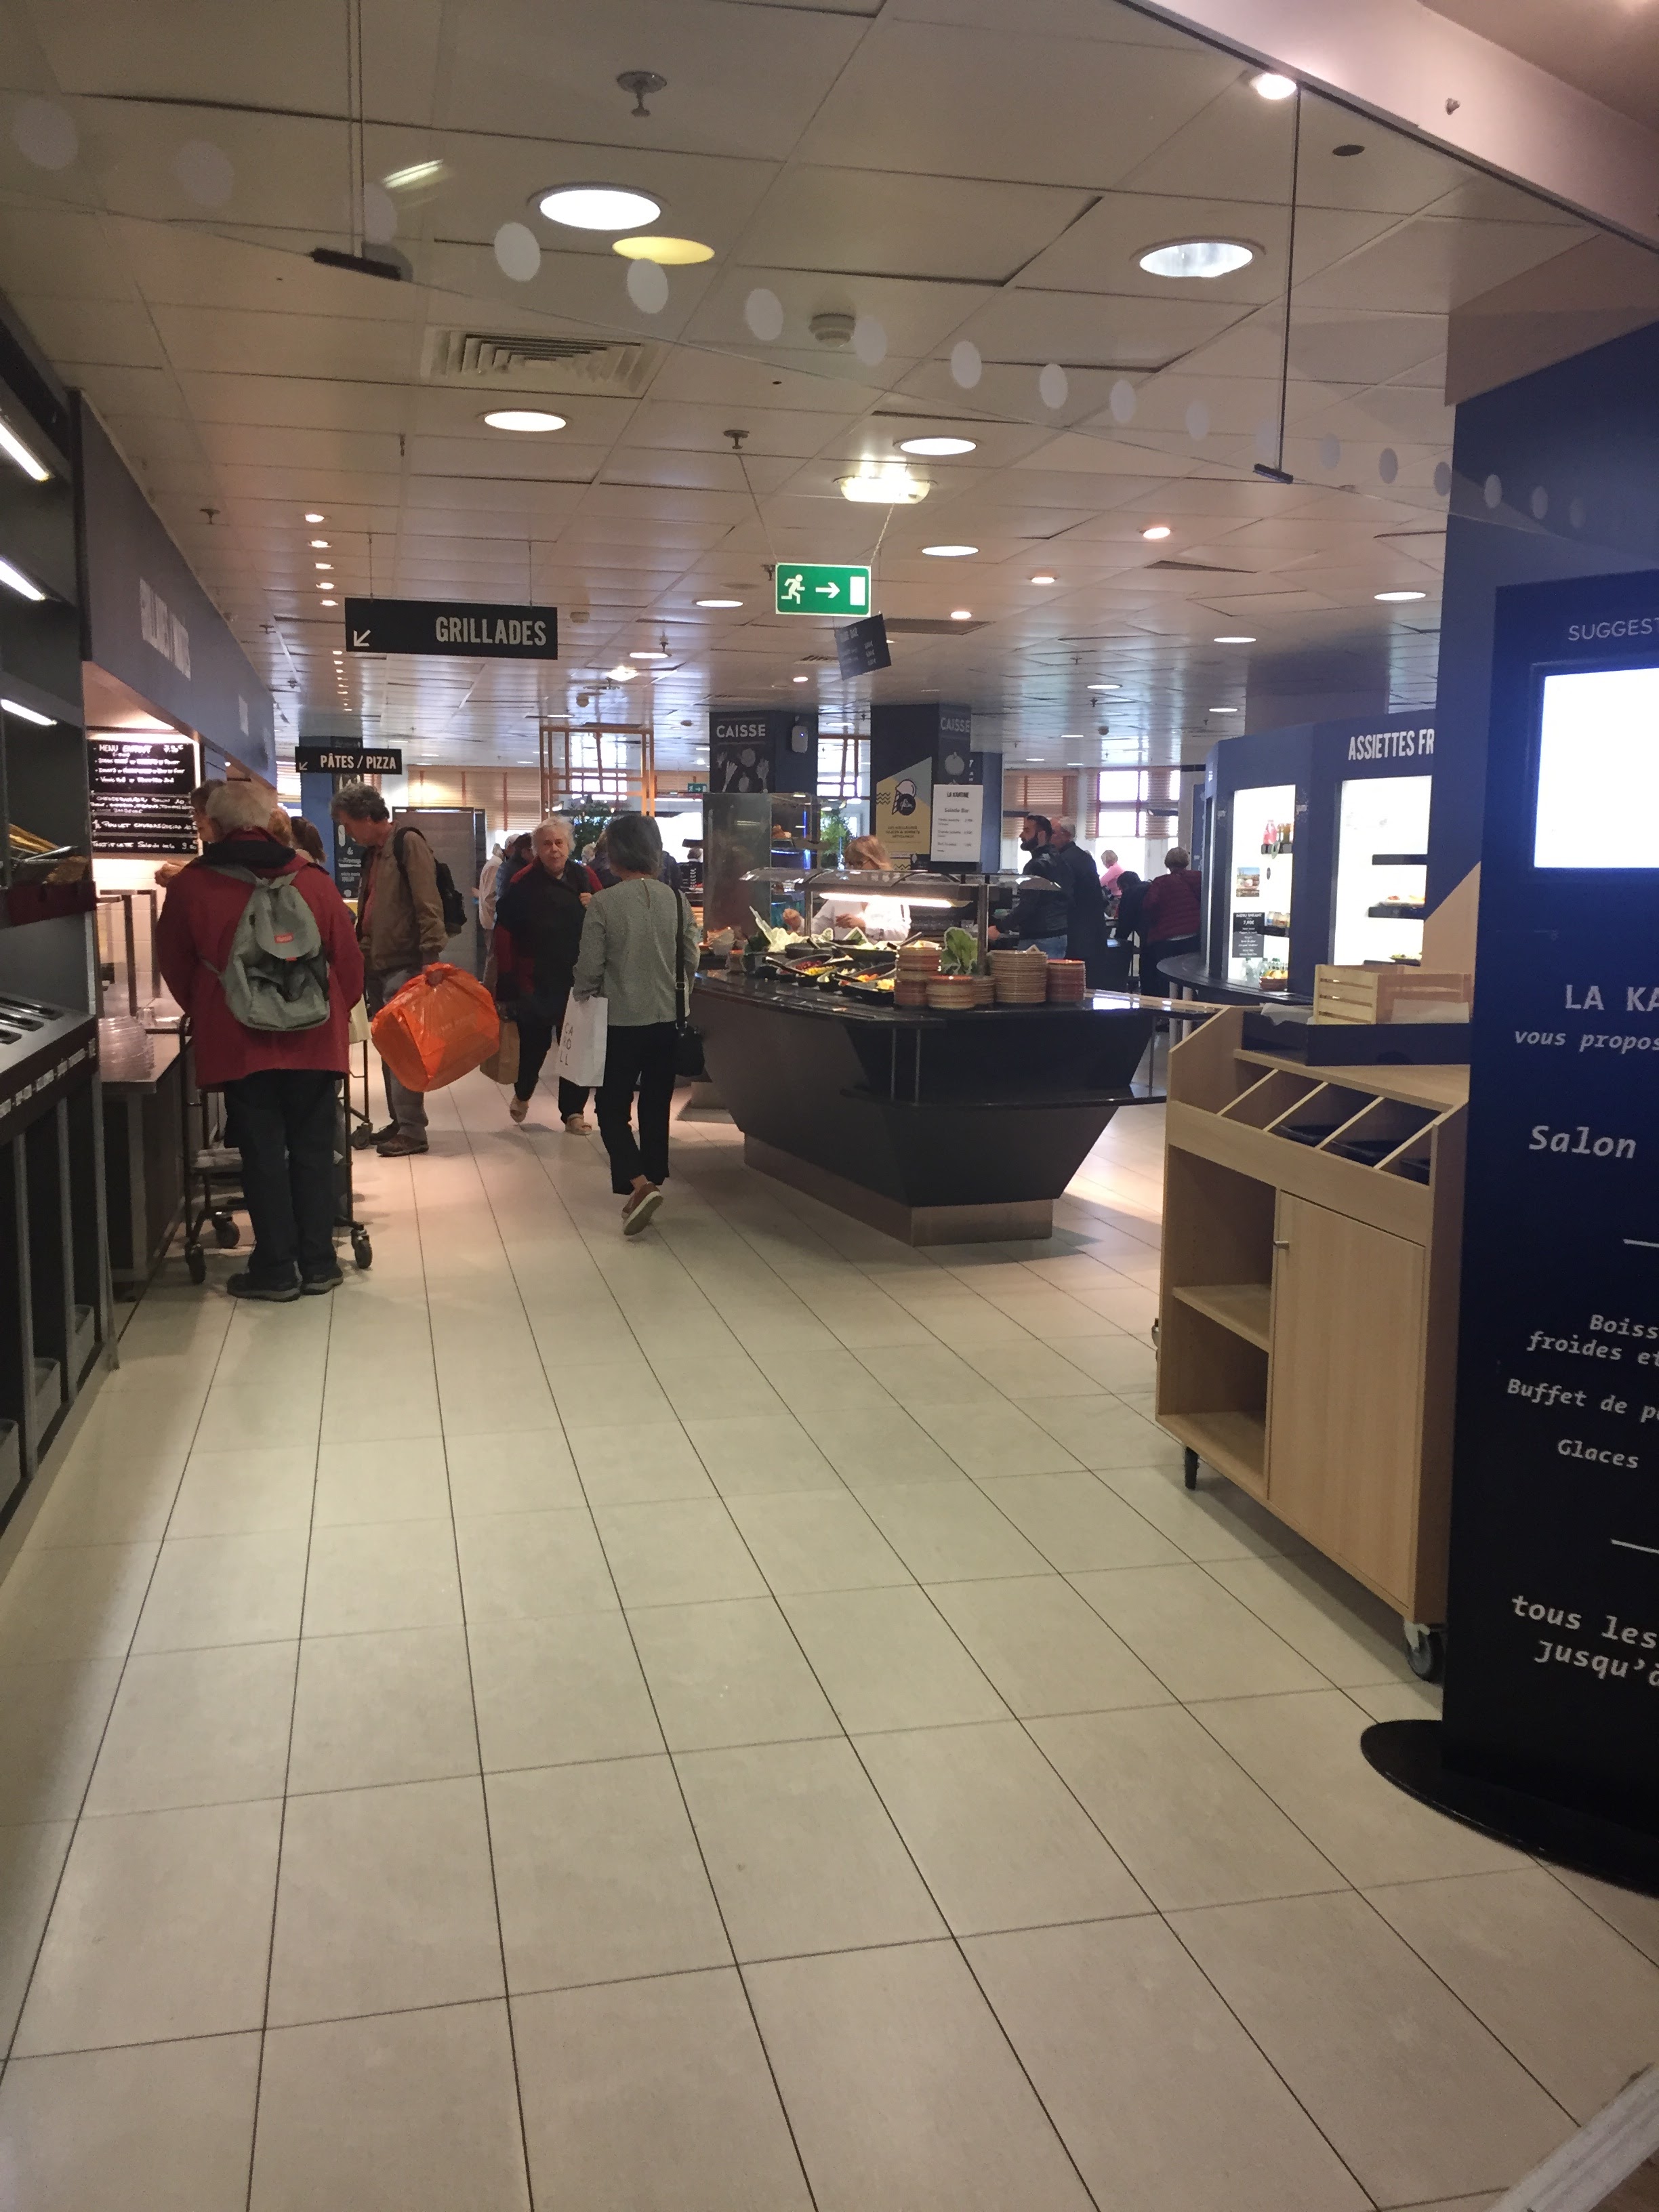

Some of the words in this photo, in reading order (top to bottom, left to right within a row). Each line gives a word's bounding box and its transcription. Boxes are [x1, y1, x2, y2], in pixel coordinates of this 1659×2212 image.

[436, 616, 547, 646] GRILLADES
[716, 724, 766, 738] CAISSE
[1348, 730, 1415, 760] ASSIETTES
[1418, 729, 1435, 754] FR
[320, 752, 354, 769] PÂTES
[366, 756, 396, 769] PIZZA
[1565, 984, 1605, 1010] LA
[1626, 986, 1659, 1012] KA
[1515, 1030, 1566, 1046] vous
[1579, 1033, 1659, 1055] propos
[1528, 1124, 1637, 1159] Salon
[1590, 1314, 1659, 1340] Boiss
[1526, 1330, 1622, 1361] froides
[1507, 1378, 1587, 1408] Buffet
[1600, 1394, 1628, 1414] de
[1640, 1405, 1659, 1424] p
[1558, 1438, 1639, 1469] Glaces
[1511, 1595, 1582, 1631] tous
[1601, 1614, 1658, 1650] les
